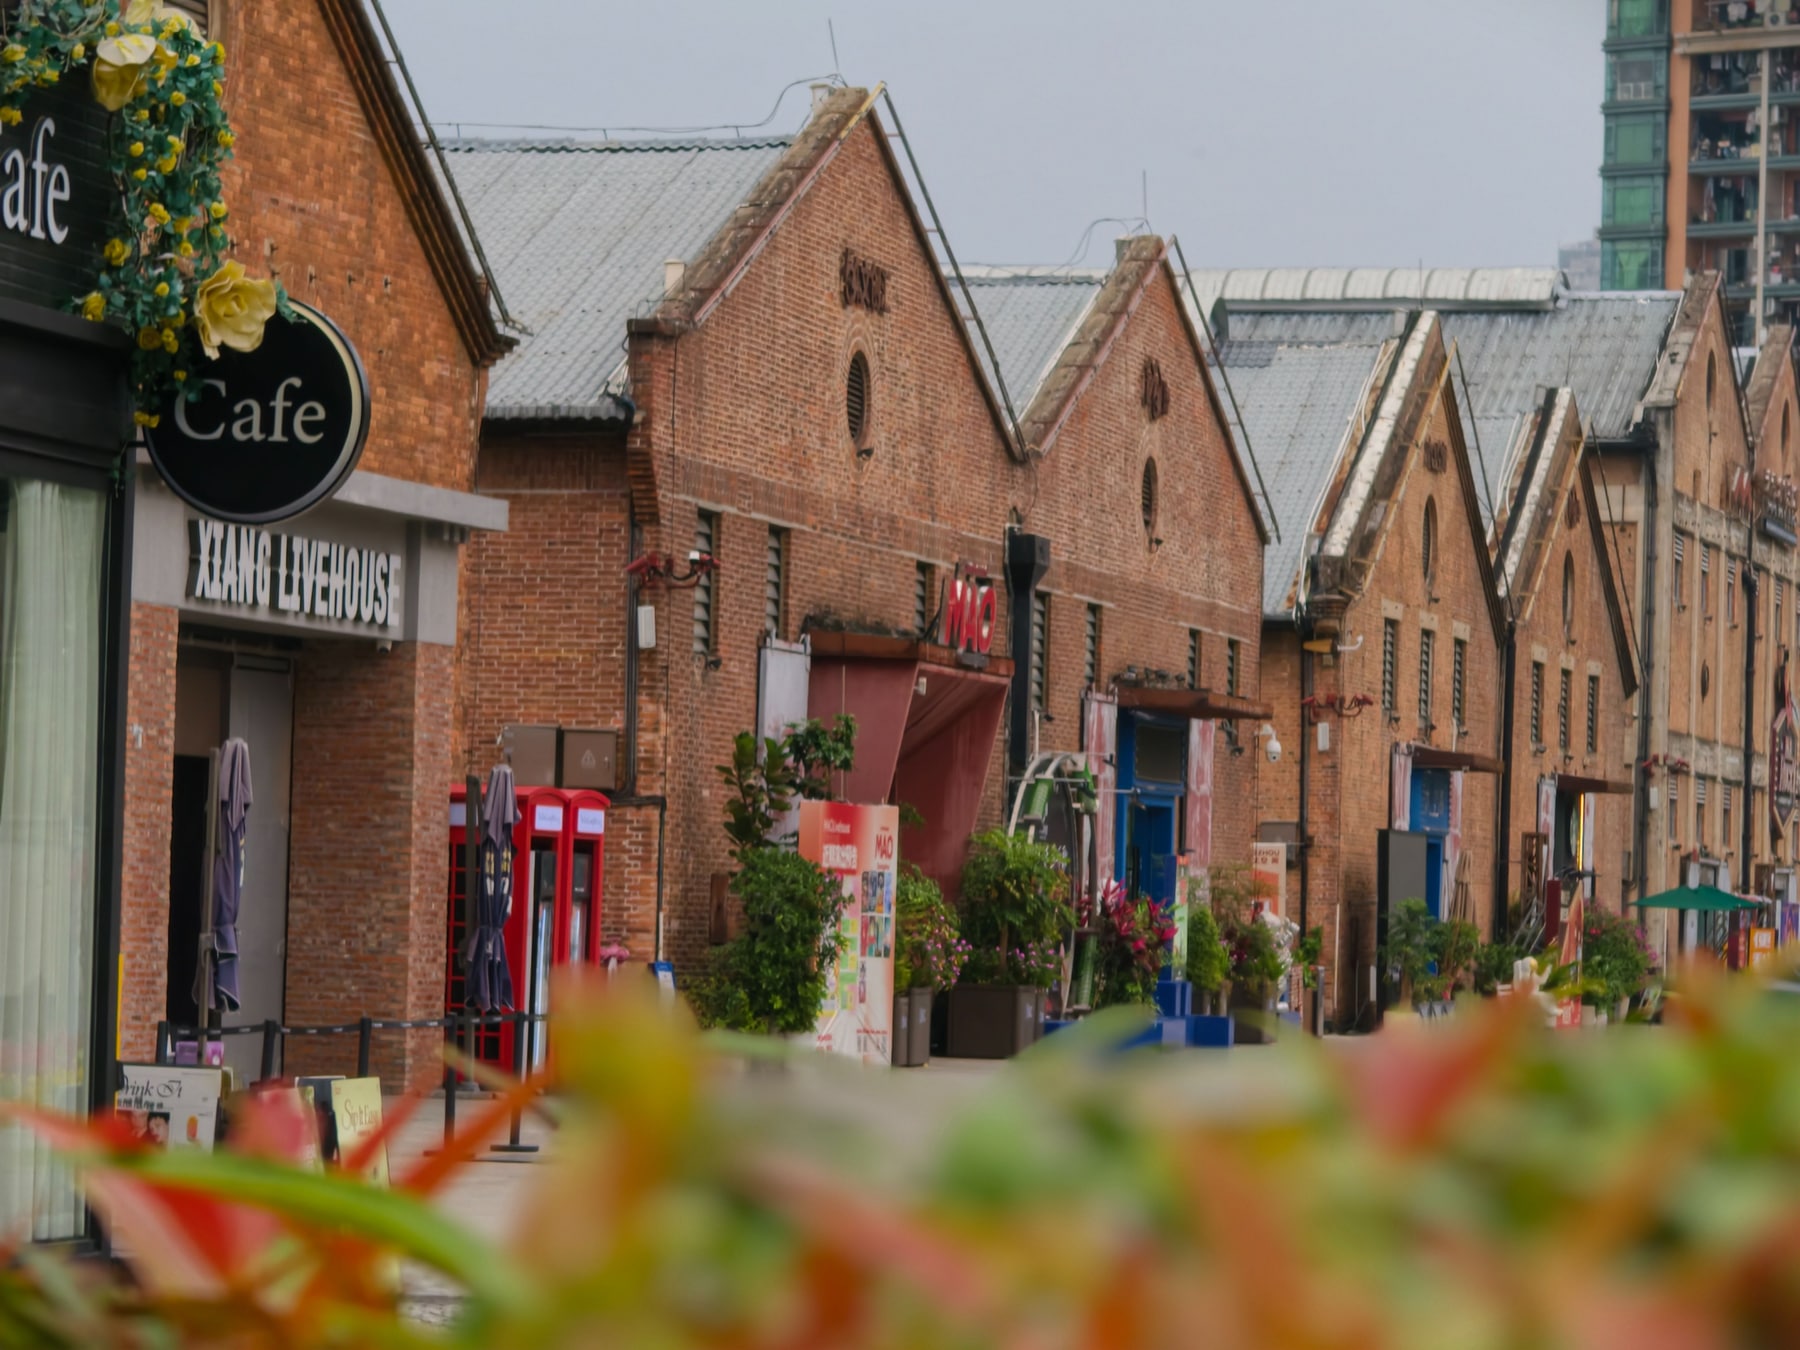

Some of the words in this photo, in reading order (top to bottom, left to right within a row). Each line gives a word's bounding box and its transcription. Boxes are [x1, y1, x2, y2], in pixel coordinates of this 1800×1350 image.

[0, 117, 71, 245] afe
[174, 376, 327, 444] Cafe
[195, 519, 271, 606] XIANG
[279, 533, 402, 626] LIVEHOUSE
[942, 578, 997, 654] MAO
[875, 833, 893, 860] MAO
